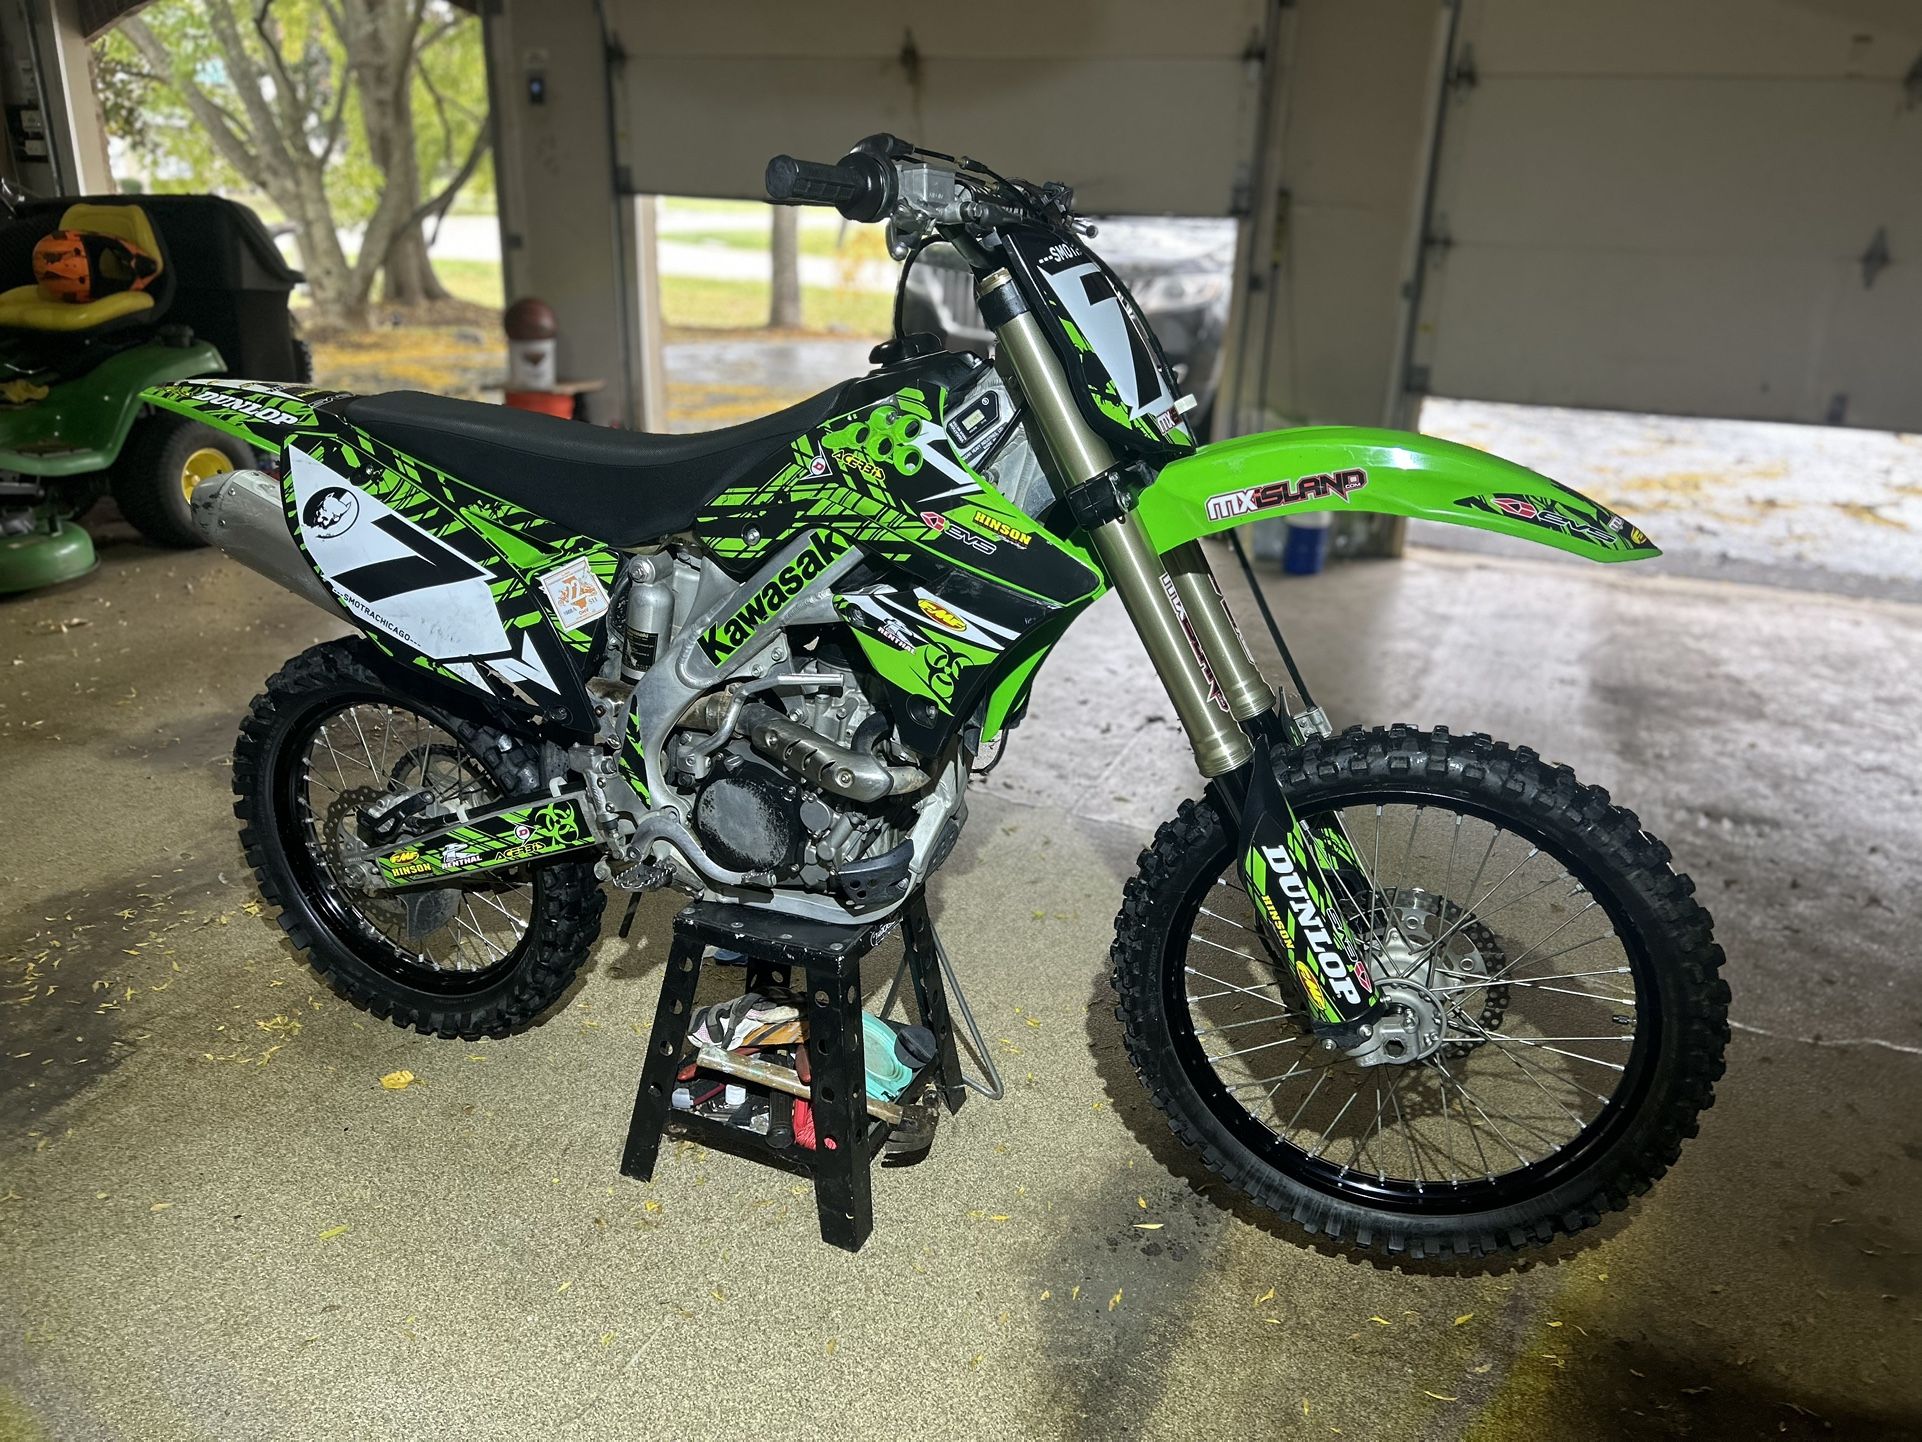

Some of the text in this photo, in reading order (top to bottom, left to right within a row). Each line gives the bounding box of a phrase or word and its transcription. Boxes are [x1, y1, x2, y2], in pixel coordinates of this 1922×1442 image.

[192, 391, 299, 425] DUNLOP
[944, 523, 997, 555] EVS
[973, 511, 1032, 546] HINSON
[1537, 510, 1617, 543] EVS
[330, 513, 487, 603] 7
[697, 532, 850, 668] Kawasak
[918, 599, 967, 631] FMF
[877, 626, 916, 655] RENTHAL
[390, 851, 419, 864] FMF
[392, 863, 431, 877] HINSON
[441, 856, 482, 869] RENTHAL
[1261, 895, 1295, 949] HINSON
[1261, 845, 1361, 1005] DUNLOP
[1296, 961, 1326, 1010] FMF
